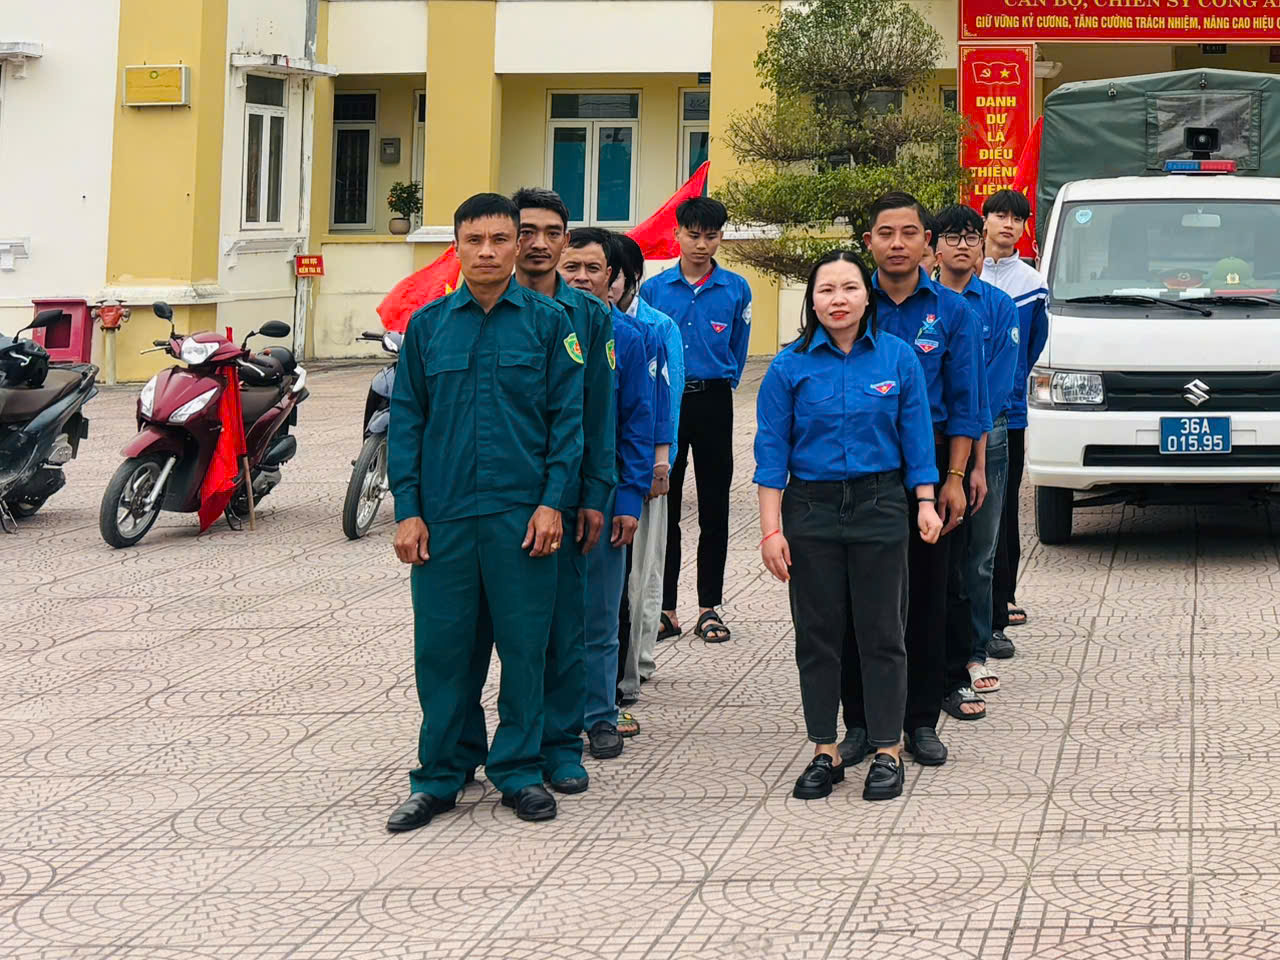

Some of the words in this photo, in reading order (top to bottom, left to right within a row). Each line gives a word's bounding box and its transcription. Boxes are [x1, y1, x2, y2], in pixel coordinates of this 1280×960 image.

[976, 14, 993, 27] GIỮ
[994, 14, 1019, 28] VỮNG
[1022, 13, 1033, 28] KỶ
[1036, 15, 1072, 29] CƯƠNG,
[1074, 15, 1099, 28] TĂNG
[1101, 15, 1132, 28] CƯỜNG
[1135, 15, 1165, 29] TRÁCH
[1168, 15, 1201, 31] NHIỆM,
[1204, 15, 1229, 29] NÂNG
[1232, 17, 1250, 29] CAO
[1253, 15, 1274, 31] HIỆU
[976, 96, 1016, 107] DANH
[986, 112, 1008, 127] DỰ
[1180, 418, 1210, 434] 36A
[1168, 435, 1223, 451] 015.95
